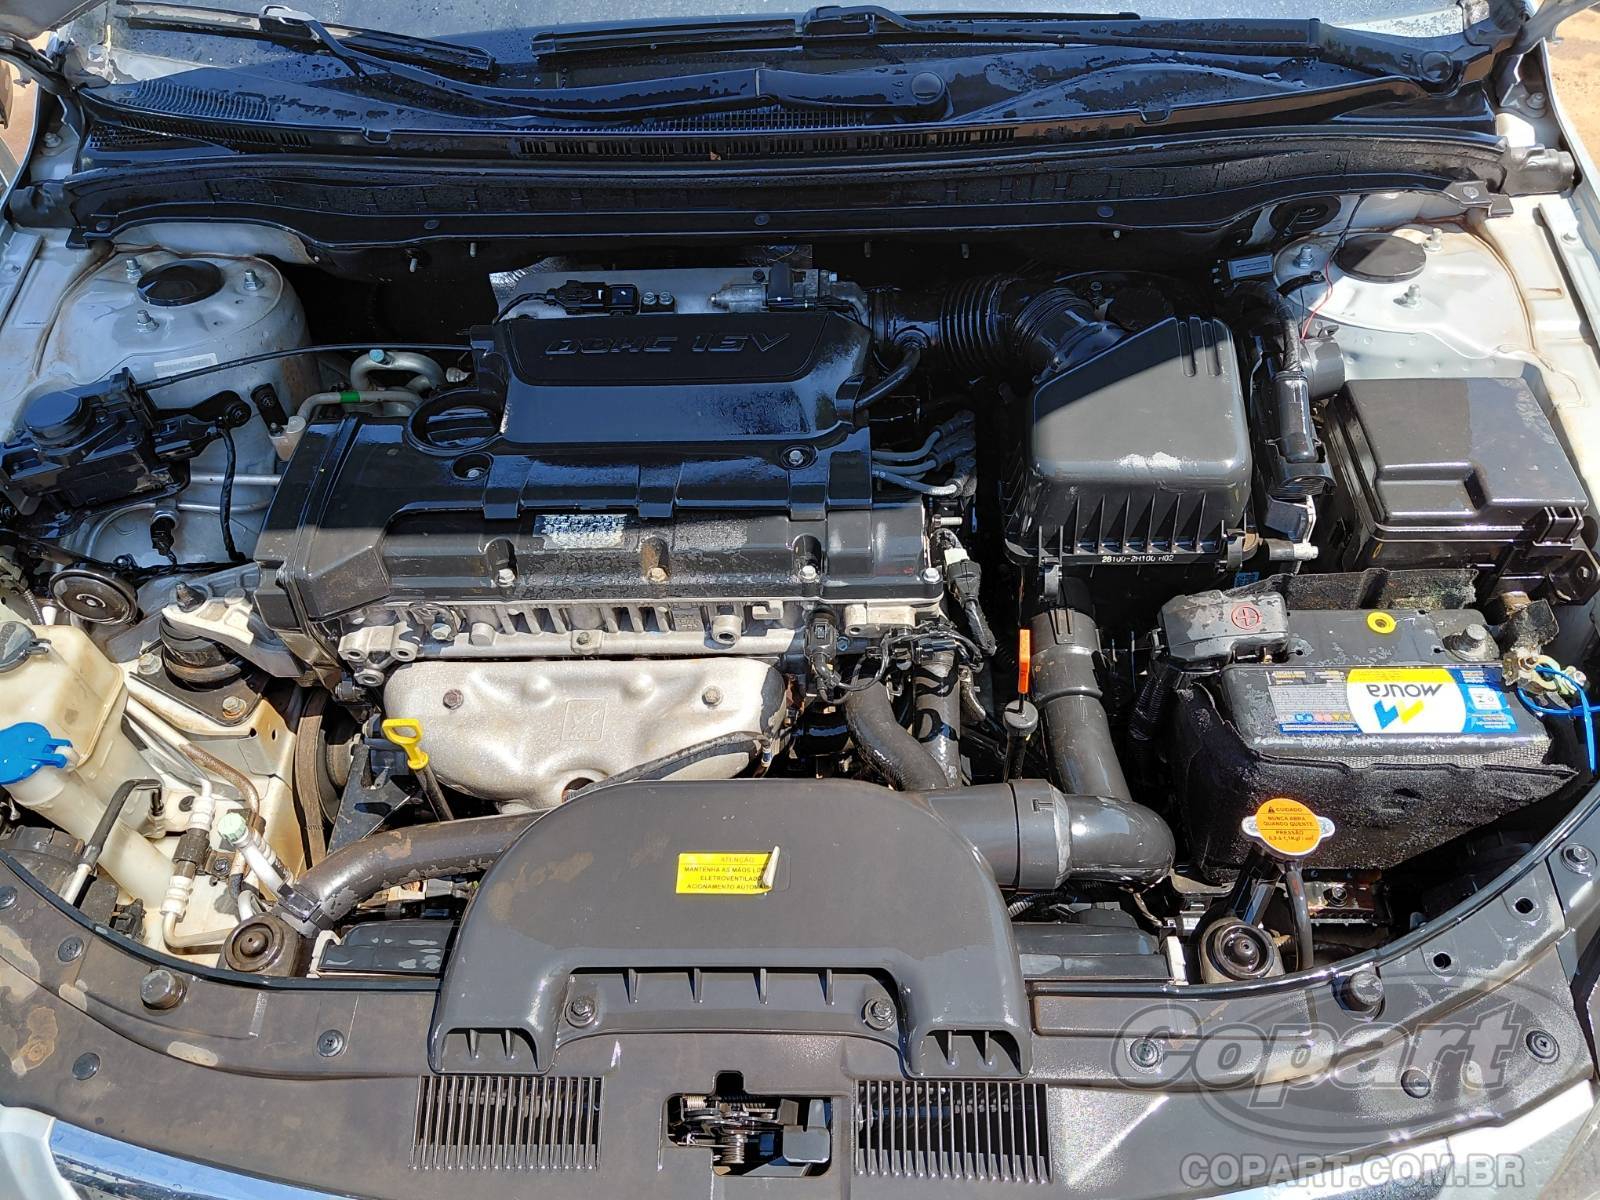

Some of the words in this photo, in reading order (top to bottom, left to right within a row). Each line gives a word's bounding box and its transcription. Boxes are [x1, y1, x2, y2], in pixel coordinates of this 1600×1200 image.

[544, 335, 678, 355] DOHC
[691, 332, 790, 353] 16V
[1101, 555, 1156, 563] 28100-2H100
